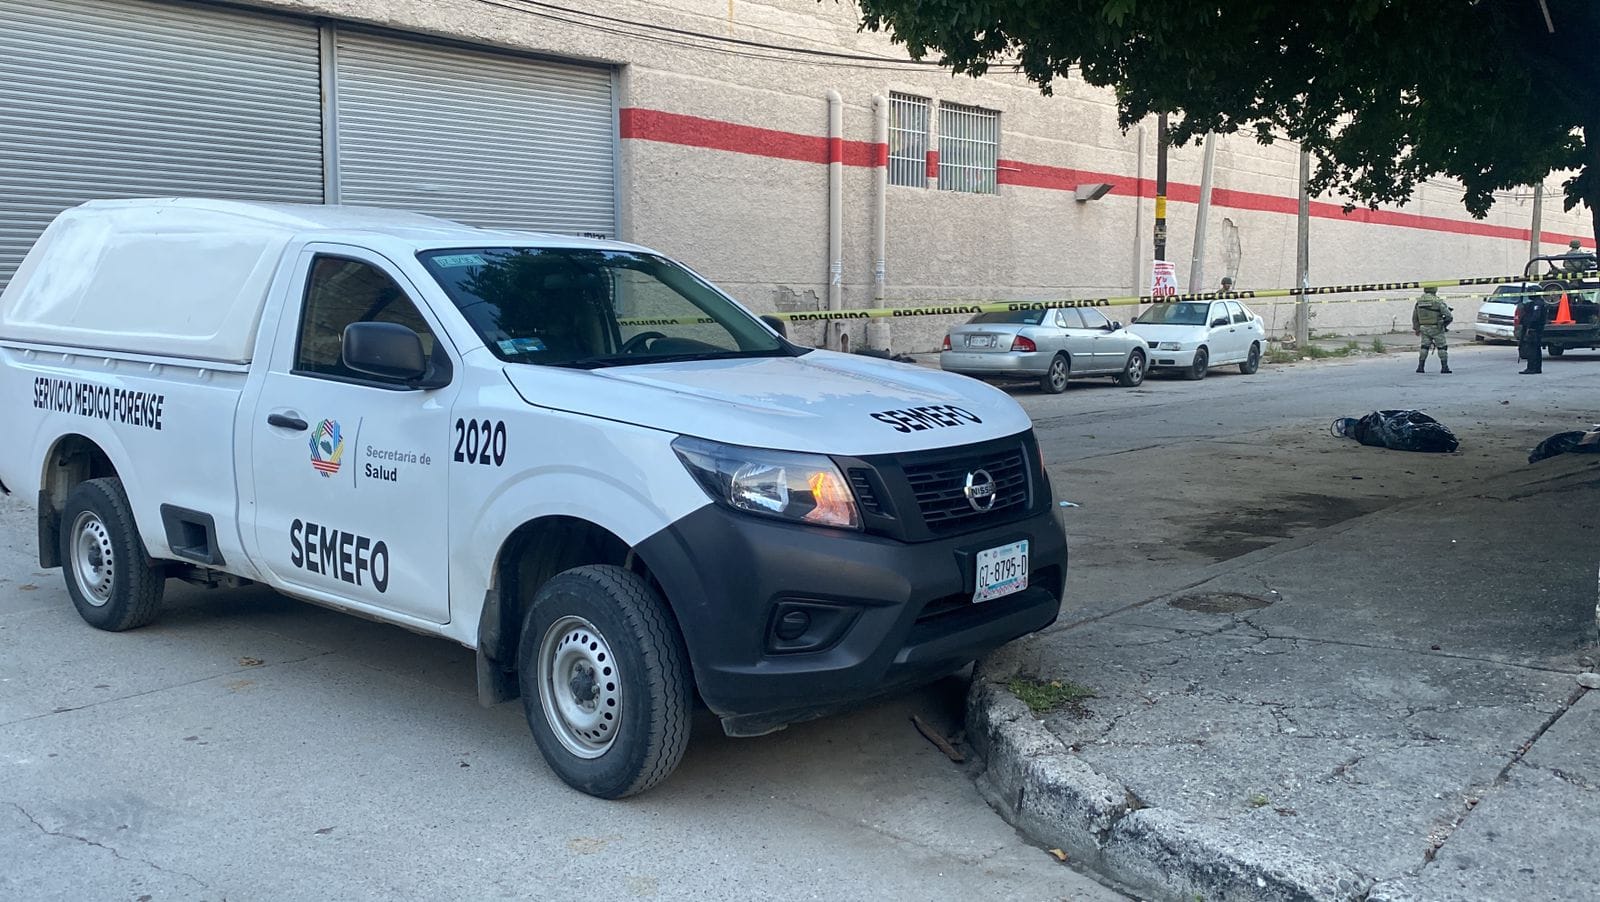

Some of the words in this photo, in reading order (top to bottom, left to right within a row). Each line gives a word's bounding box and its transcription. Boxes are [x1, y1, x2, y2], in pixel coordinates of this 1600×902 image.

[1152, 284, 1175, 297] auto
[33, 376, 73, 413] SERVICIO
[74, 382, 111, 420] MEDICO
[113, 388, 165, 431] FORENSE
[870, 405, 982, 433] SEMEFO
[453, 417, 507, 467] 2020
[365, 462, 397, 482] Salud
[419, 453, 431, 466] de
[289, 518, 389, 594] SEMEFO
[980, 554, 1027, 588] GZ-8795-D
